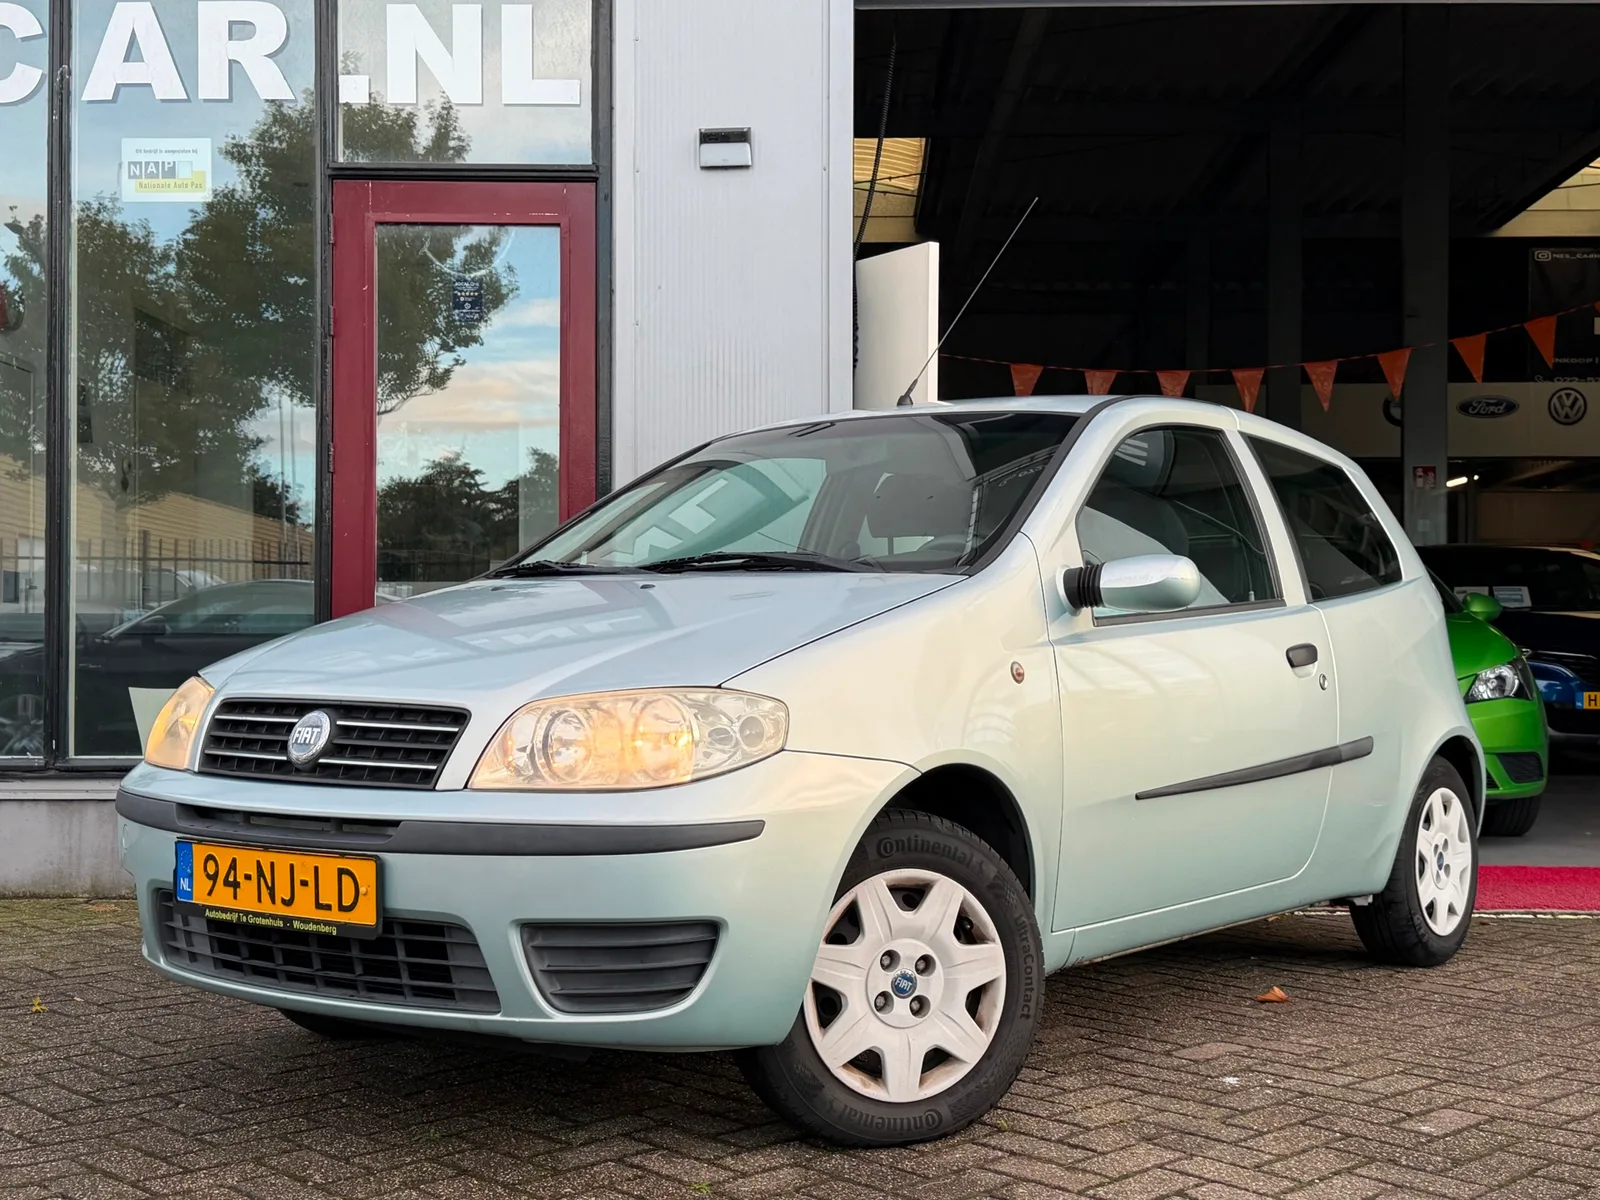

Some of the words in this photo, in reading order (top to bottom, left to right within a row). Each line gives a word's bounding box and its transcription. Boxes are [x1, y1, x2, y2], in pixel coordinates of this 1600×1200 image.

[130, 160, 174, 176] NAP
[138, 181, 171, 189] Nationale
[173, 181, 189, 189] Auto
[190, 181, 203, 189] Pas
[1468, 399, 1506, 415] Ford
[293, 727, 321, 745] FIAT
[876, 834, 975, 869] Continental
[179, 877, 191, 892] NL
[203, 852, 360, 913] 94-NJ-LD
[205, 908, 238, 923] Autobedrijf
[239, 913, 247, 923] Te
[248, 915, 284, 928] Grotenhuis
[293, 920, 337, 935] Woudenberg
[895, 976, 913, 992] FIAT
